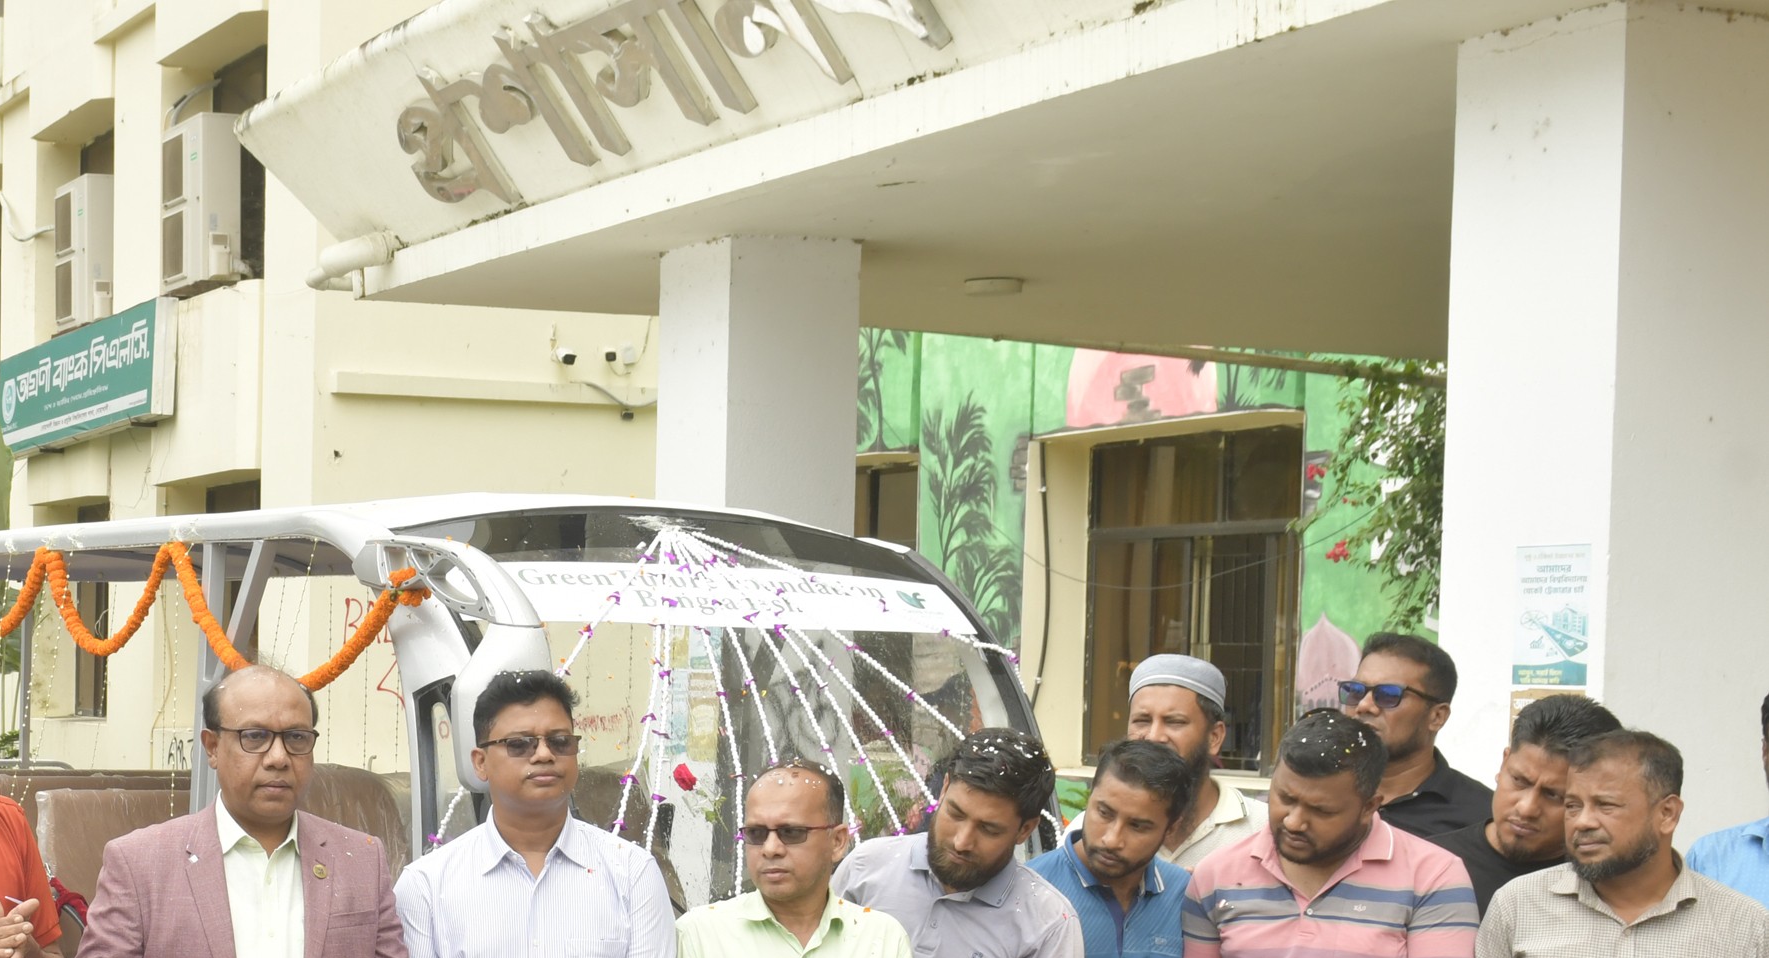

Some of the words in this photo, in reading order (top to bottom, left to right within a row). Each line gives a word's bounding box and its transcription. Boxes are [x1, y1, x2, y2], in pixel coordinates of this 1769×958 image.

[16, 357, 51, 403] অগ্রণী
[53, 350, 88, 391] ব্যাংক
[518, 567, 613, 586] Green
